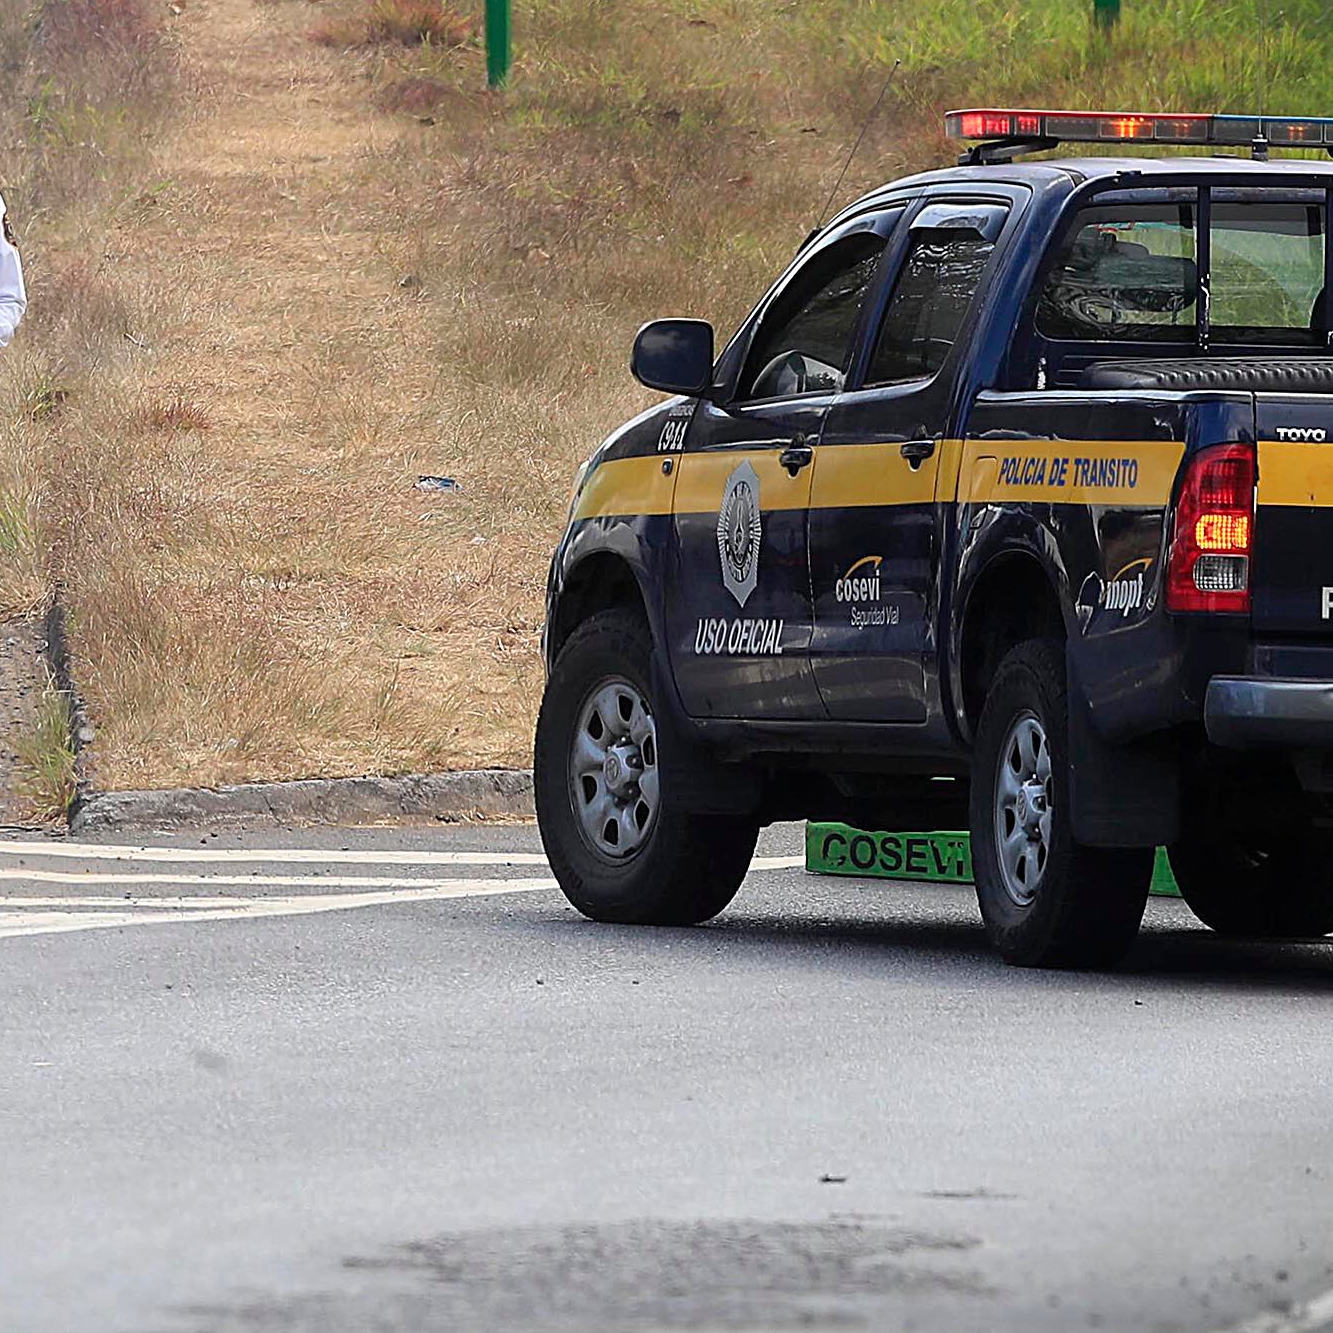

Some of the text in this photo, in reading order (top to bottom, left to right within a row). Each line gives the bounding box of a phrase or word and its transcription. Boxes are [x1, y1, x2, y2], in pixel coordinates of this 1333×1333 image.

[998, 457, 1138, 488] POLICIA DE TRANSITO
[835, 569, 880, 602] cosevi
[1104, 572, 1144, 617] mopt
[850, 606, 886, 630] Seguridad
[694, 619, 785, 654] USO OFICIAL
[823, 833, 964, 876] COSEVI
